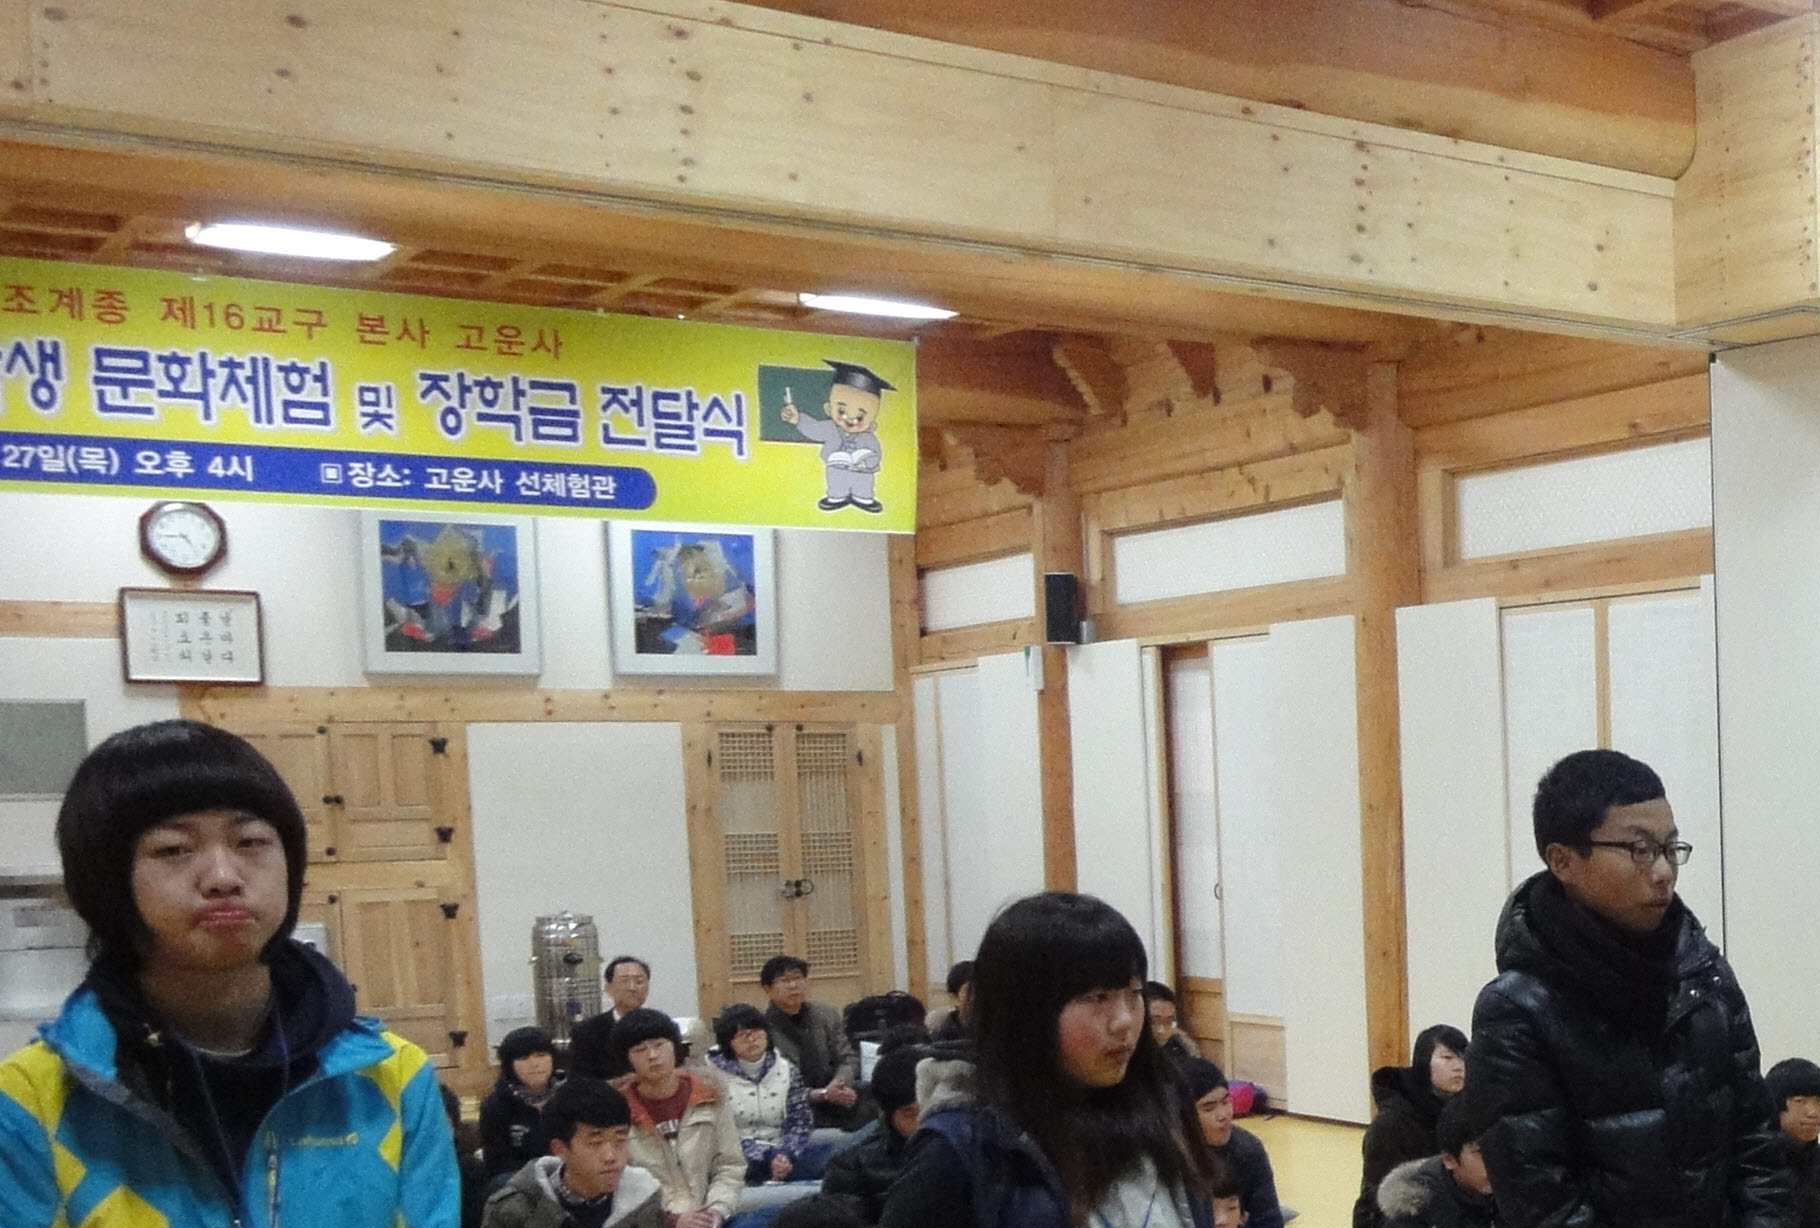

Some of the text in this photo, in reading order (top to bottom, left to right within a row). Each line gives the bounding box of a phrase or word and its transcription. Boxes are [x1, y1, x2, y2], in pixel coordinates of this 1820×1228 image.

[2, 284, 563, 360] 조계종 제16교구 본사 고운사
[0, 339, 746, 457] 생 문화체험 및 장학금 전달식
[3, 444, 121, 476] 27일(목)
[134, 450, 195, 479] 오후
[207, 454, 254, 482] 4시
[424, 466, 503, 494] 고운사
[515, 467, 617, 500] 선체험관
